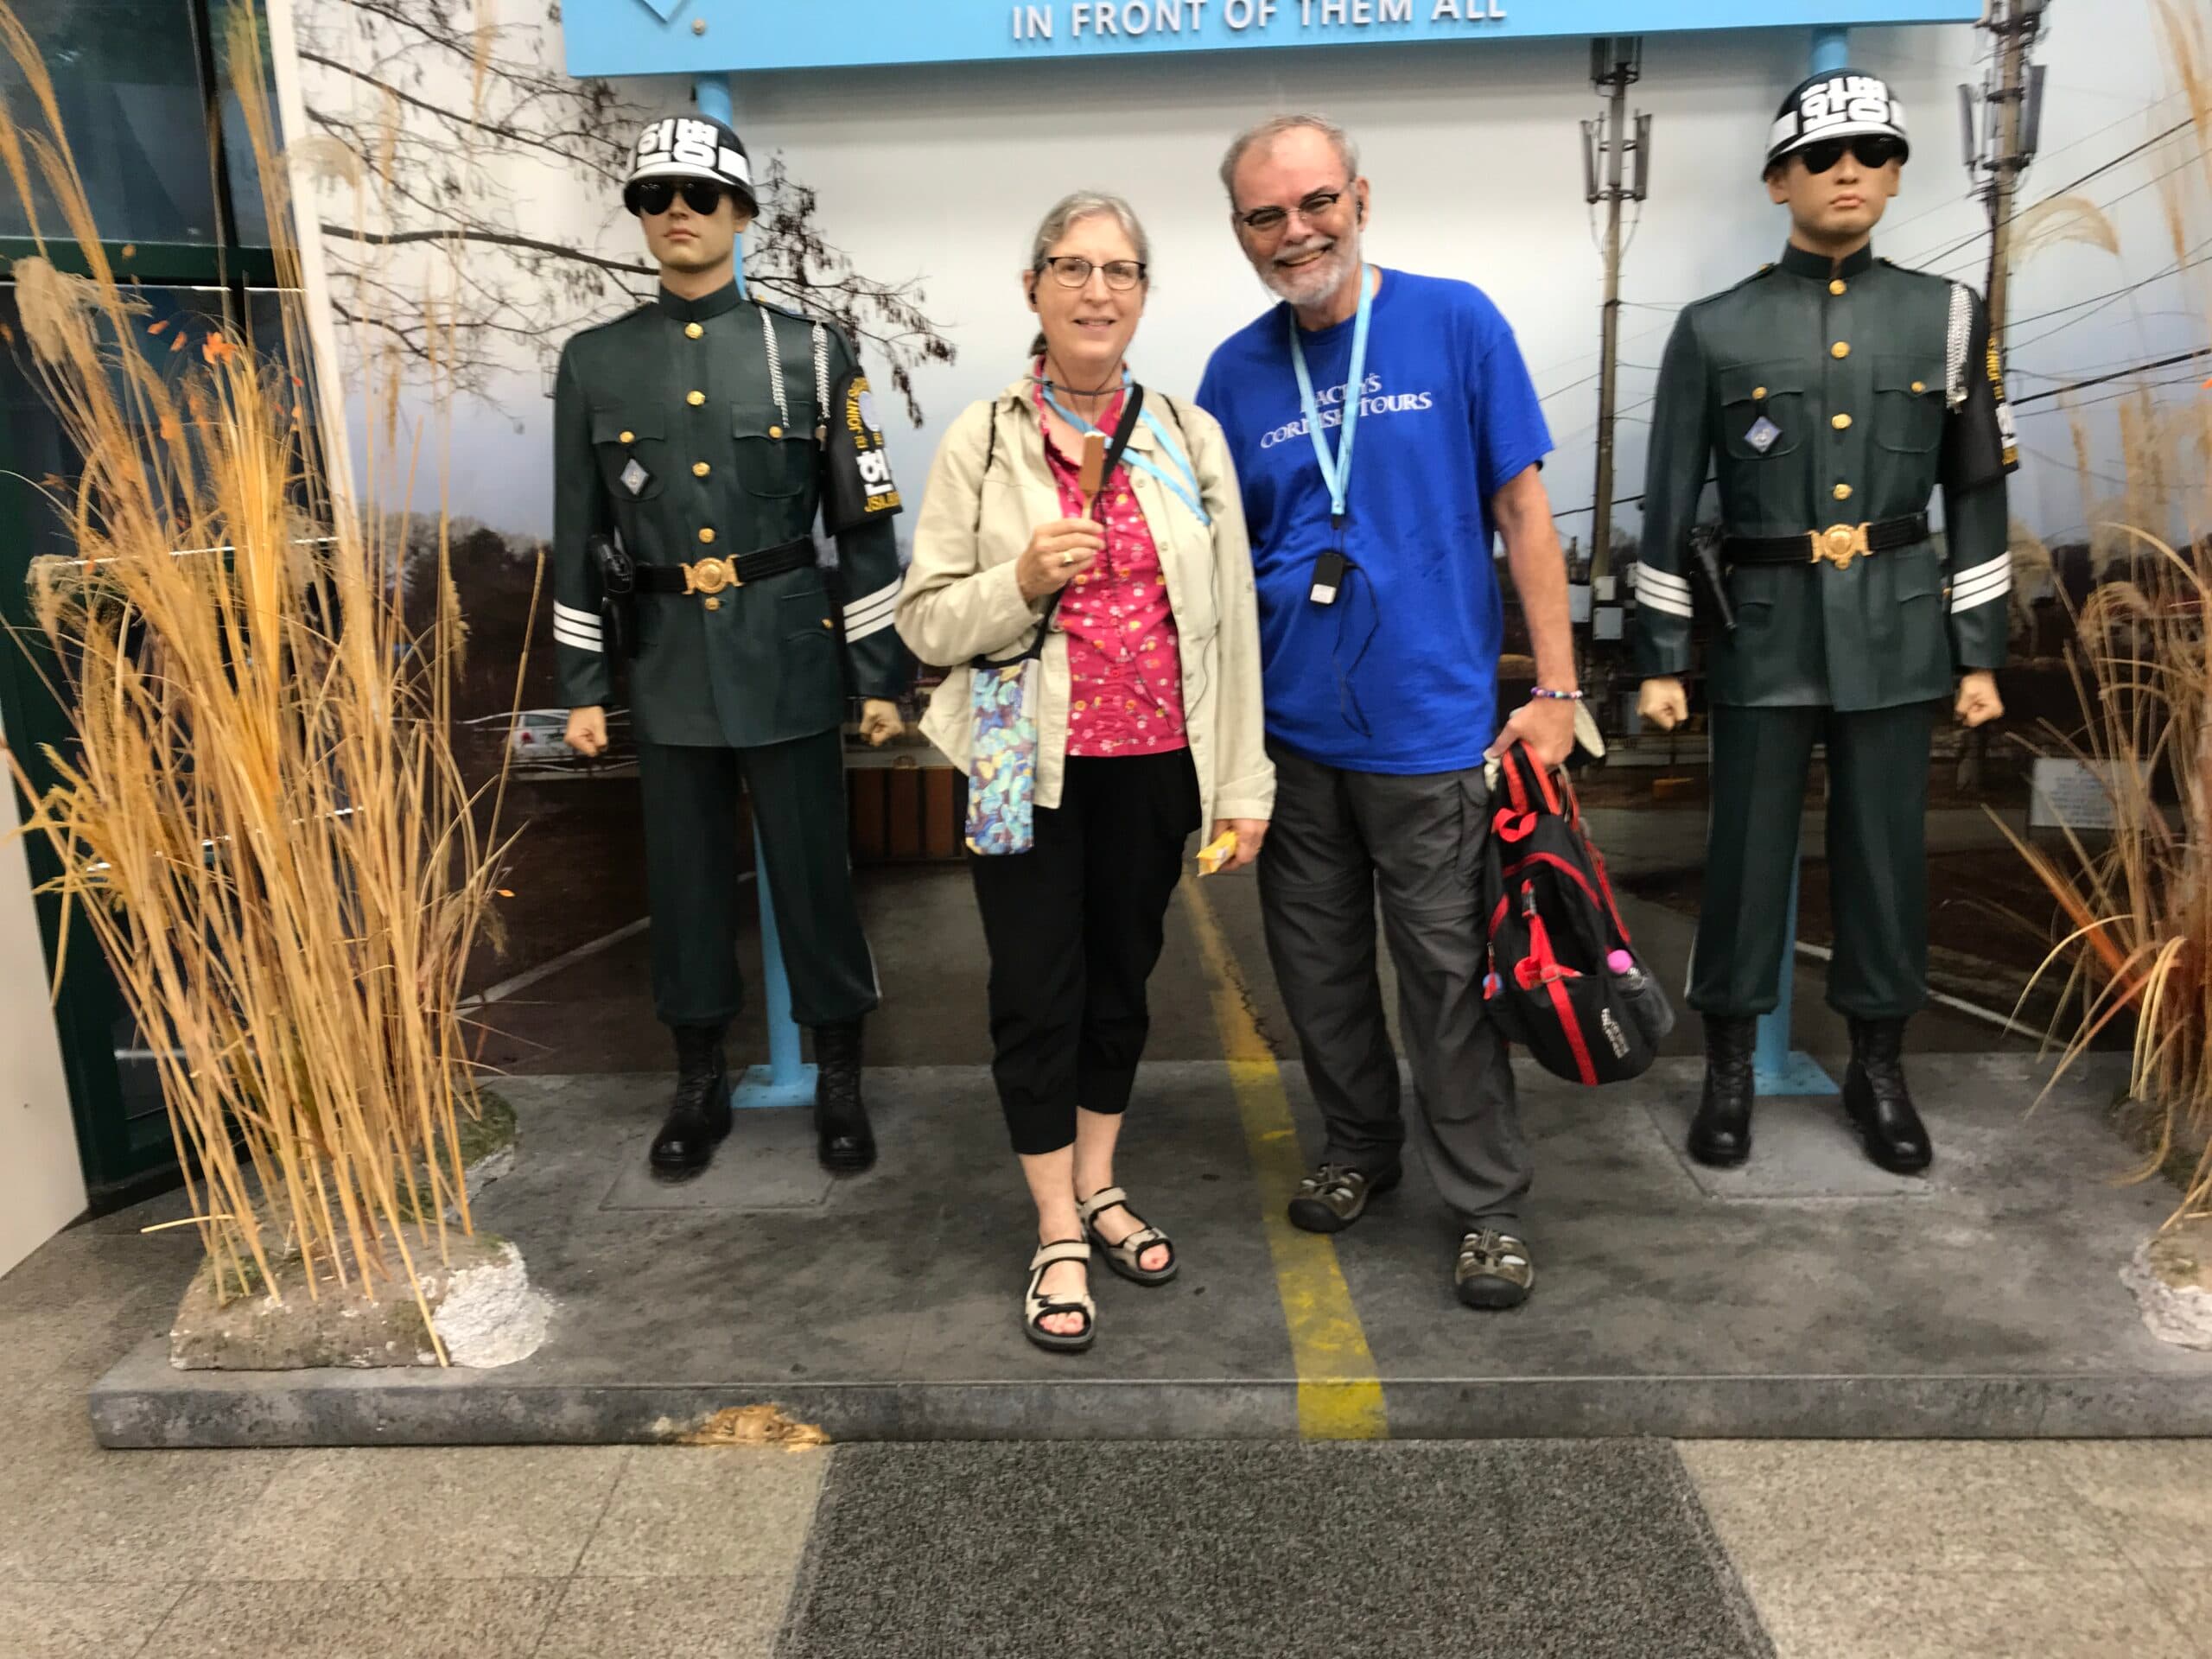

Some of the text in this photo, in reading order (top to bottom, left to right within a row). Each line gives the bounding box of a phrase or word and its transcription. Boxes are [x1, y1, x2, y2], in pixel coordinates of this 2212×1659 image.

[1013, 0, 1508, 40] IN FRONT OF THEM ALL
[1357, 391, 1433, 417] TOURS
